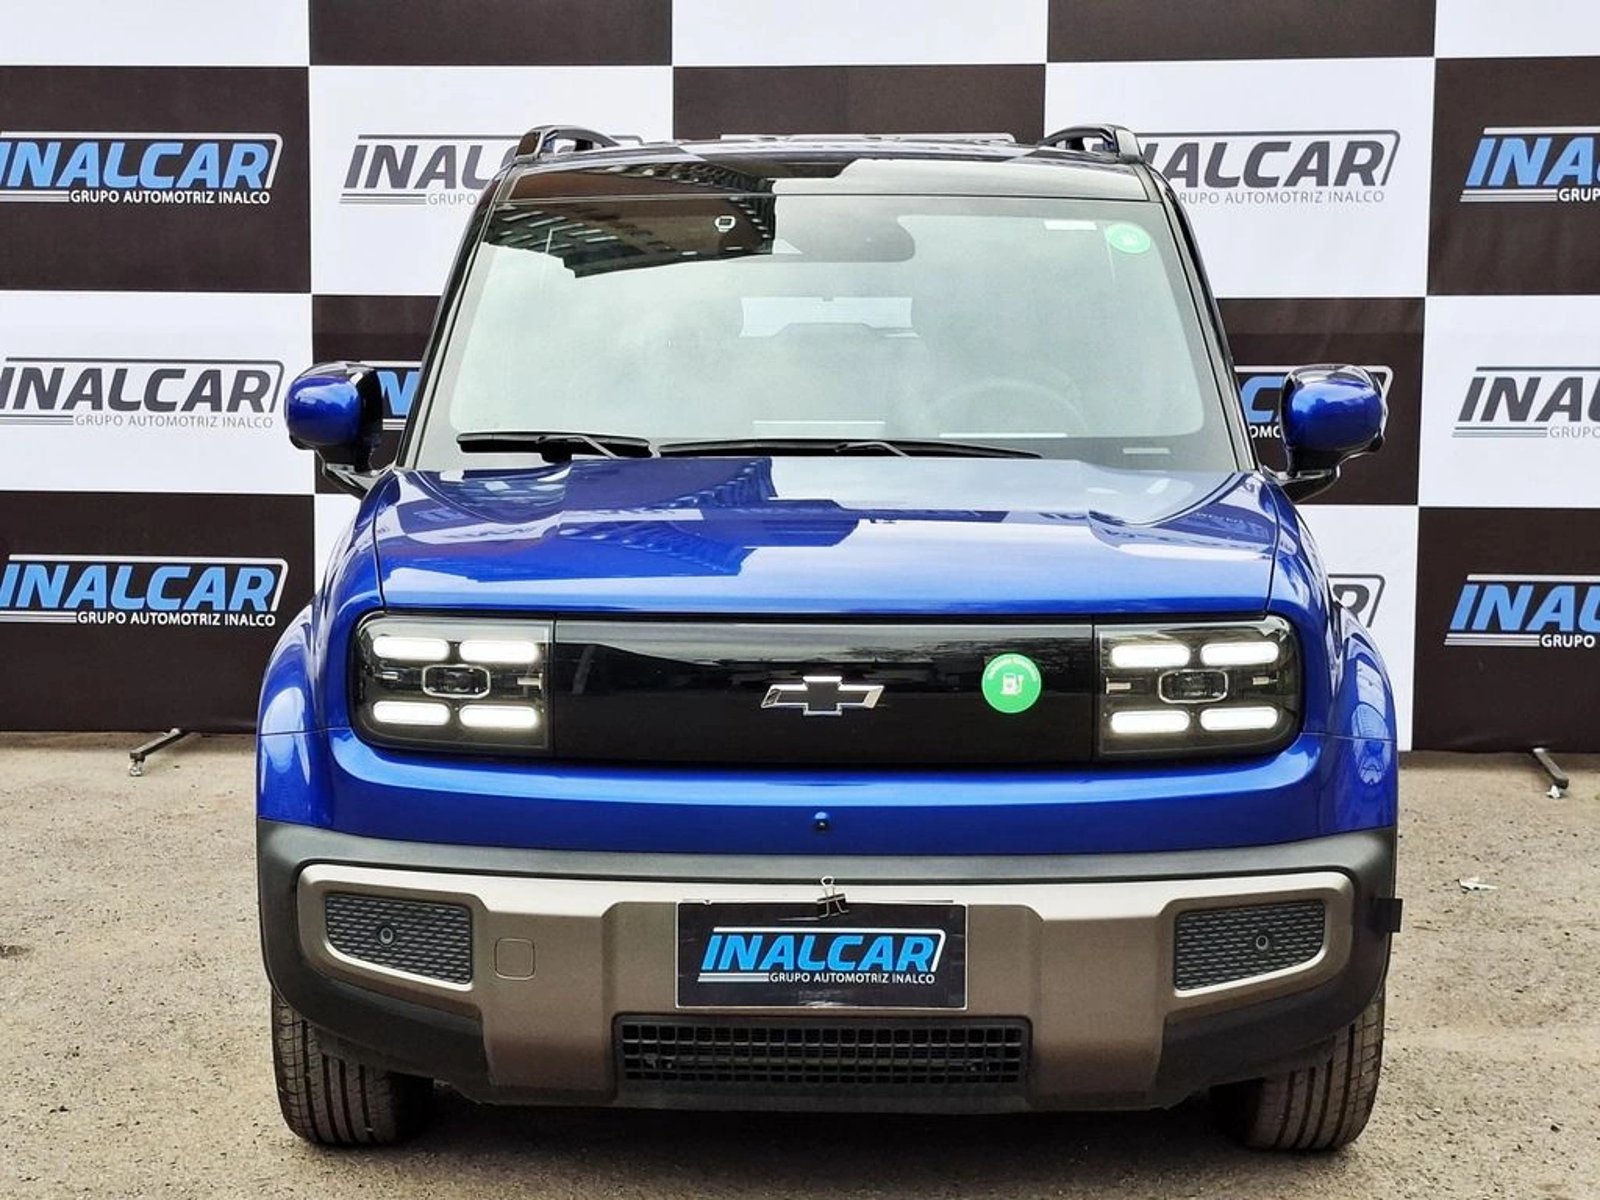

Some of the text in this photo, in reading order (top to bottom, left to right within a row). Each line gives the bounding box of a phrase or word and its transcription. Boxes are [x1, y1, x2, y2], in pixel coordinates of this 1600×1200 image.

[71, 190, 270, 204] GRUPO AUTOMOTRIZ INALCO
[428, 193, 477, 205] GRUPO
[1224, 191, 1323, 204] AUTOMOTRIZ
[1328, 190, 1385, 203] INALCO
[75, 414, 274, 429] GRUPO AUTOMOTRIZ INALCO
[0, 564, 275, 612] INALCAR
[77, 611, 276, 627] GRUPO AUTOMOTRIZ INALCO
[1541, 634, 1596, 648] GRUPO
[701, 934, 935, 972] INALCAR
[769, 972, 935, 984] GRUPO AUTOMOTRIZ INALCO
